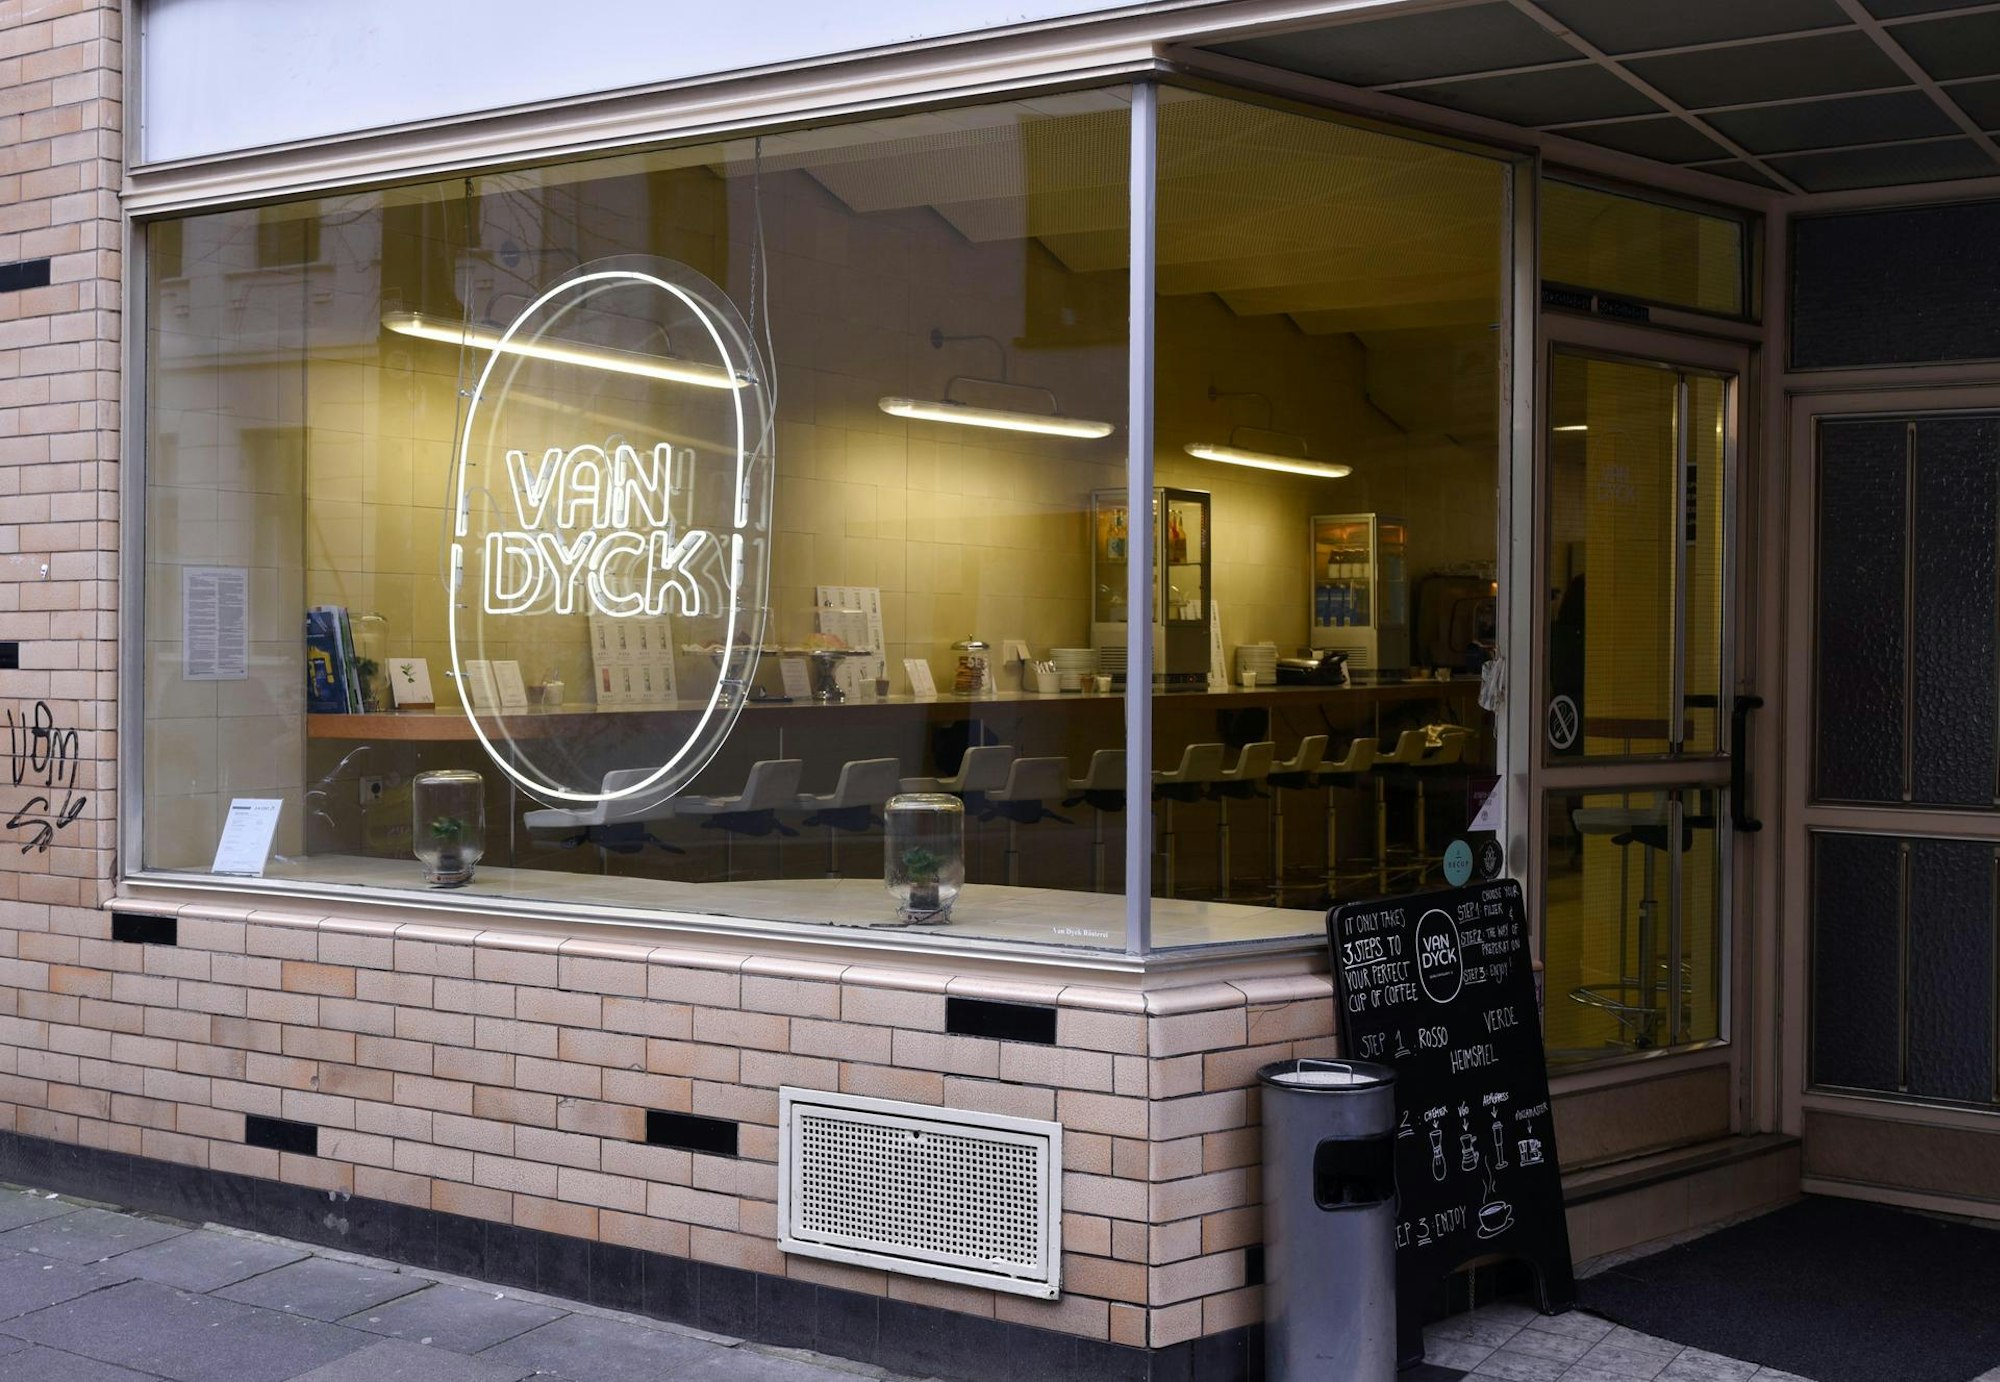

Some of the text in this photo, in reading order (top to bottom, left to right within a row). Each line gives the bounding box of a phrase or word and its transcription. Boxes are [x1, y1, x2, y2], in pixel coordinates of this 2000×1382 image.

[506, 442, 671, 529] VAN
[484, 530, 707, 617] DYCK
[1503, 884, 1520, 899] YOUR
[1066, 928, 1082, 938] Dyck
[1344, 908, 1406, 936] IT ONLY TAKES
[1388, 934, 1402, 957] TO
[1423, 933, 1450, 952] VAN
[1421, 947, 1457, 969] DYCK
[1345, 960, 1411, 992] YOUR PERFECT
[1348, 982, 1419, 1013] CUP OF COFFEE
[1483, 1006, 1519, 1034] VERDE
[1359, 1031, 1386, 1058] STEP
[1417, 1026, 1449, 1049] ROSSO
[1450, 1044, 1500, 1074] HEIMSPIEL
[1423, 1105, 1449, 1122] CHEMEX
[1434, 1204, 1467, 1237] ENJOY
